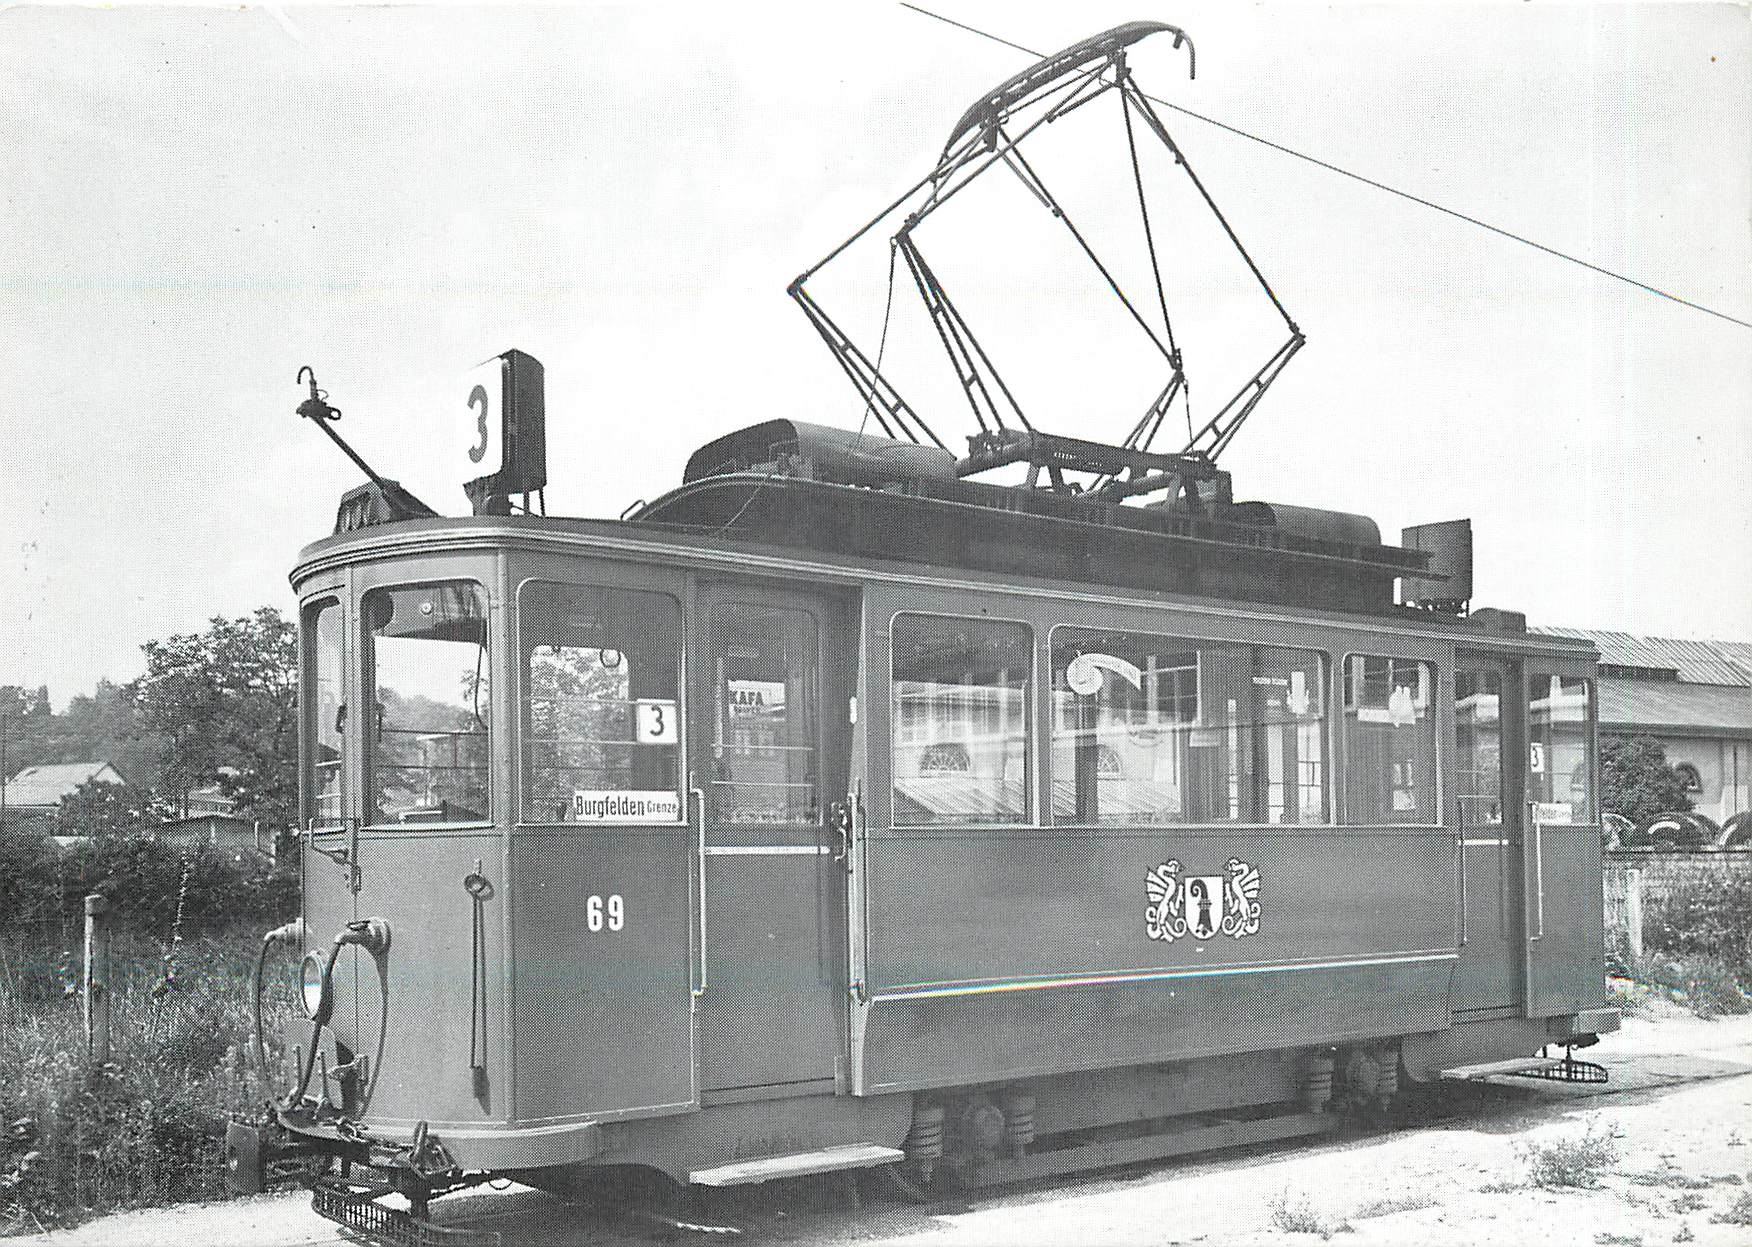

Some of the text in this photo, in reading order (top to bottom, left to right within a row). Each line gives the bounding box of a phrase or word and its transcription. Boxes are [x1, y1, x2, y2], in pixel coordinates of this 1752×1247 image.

[467, 384, 489, 464] 3
[650, 705, 665, 736] 3
[1532, 747, 1539, 767] 3
[576, 795, 678, 818] Burgfelden Grenze
[587, 894, 624, 932] 69
